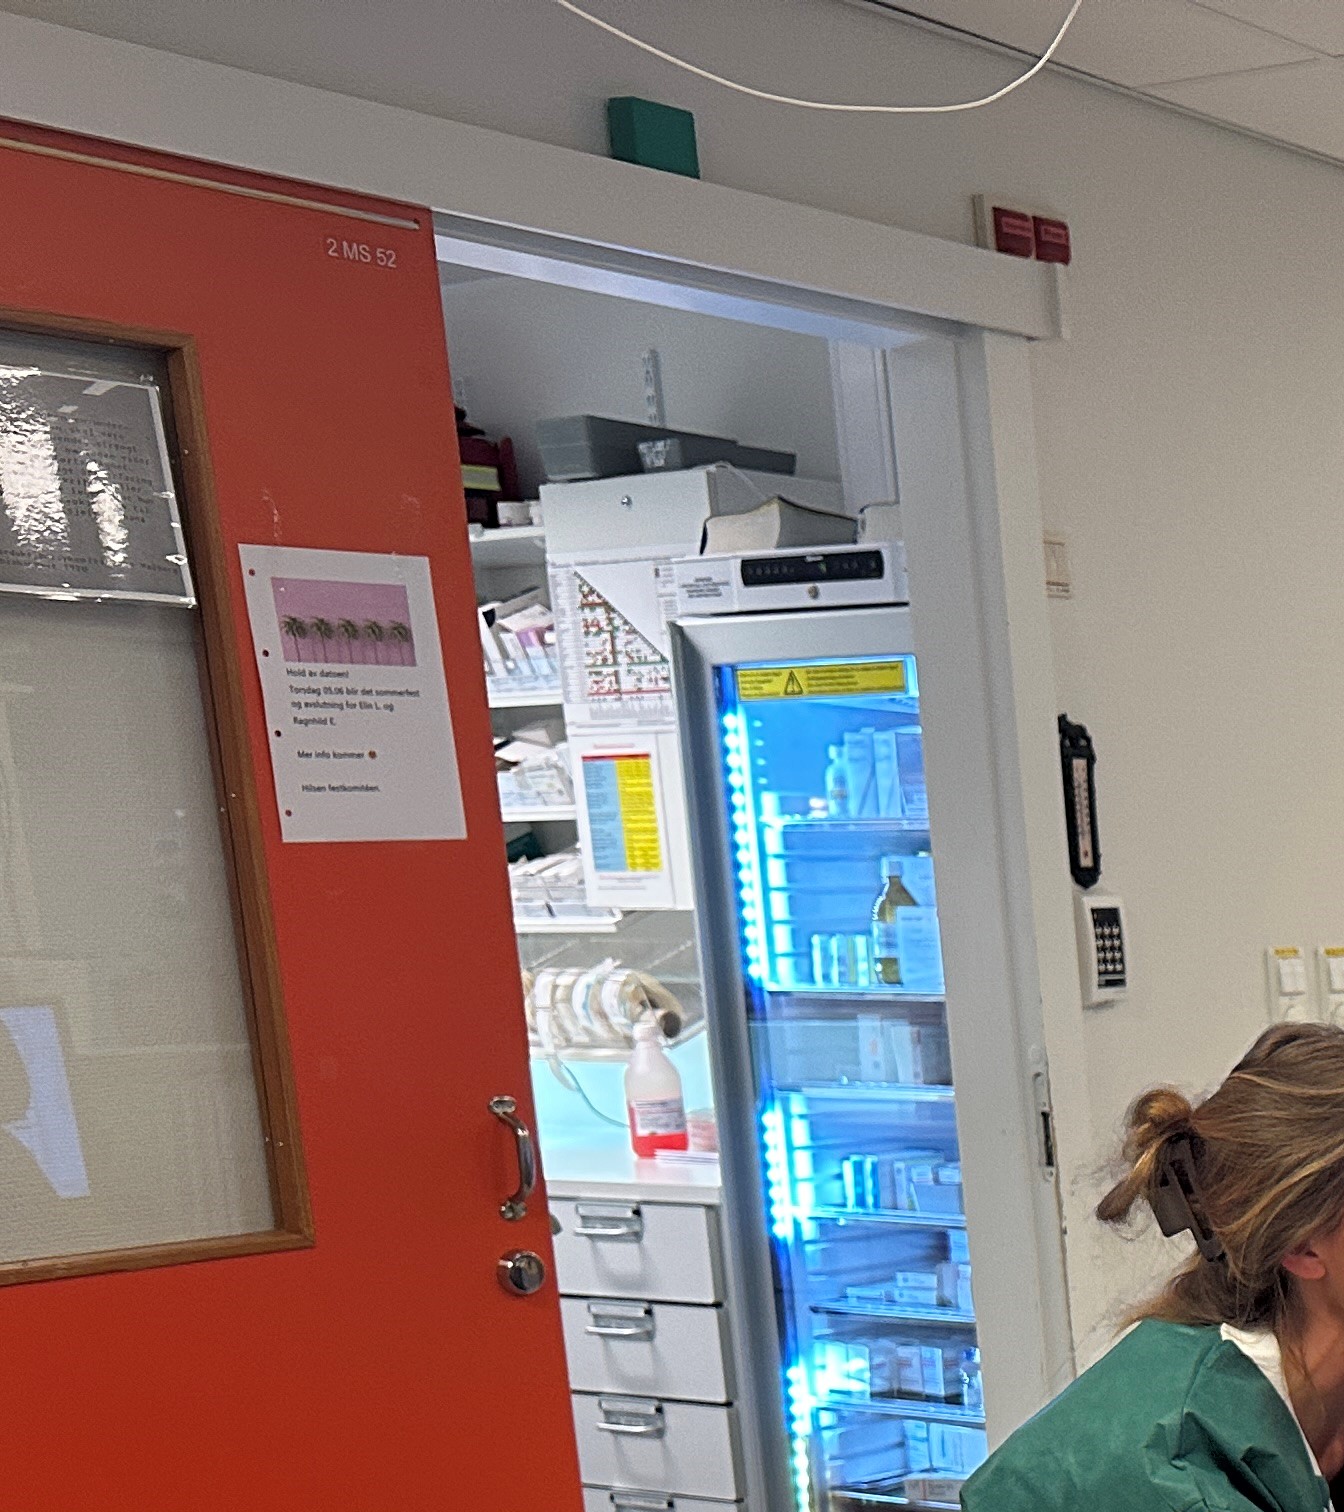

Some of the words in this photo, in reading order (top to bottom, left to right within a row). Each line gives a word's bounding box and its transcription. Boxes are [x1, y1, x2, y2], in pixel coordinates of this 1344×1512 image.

[326, 238, 339, 257] 2
[342, 240, 372, 263] MS
[376, 247, 397, 269] 52
[297, 750, 313, 759] Mer
